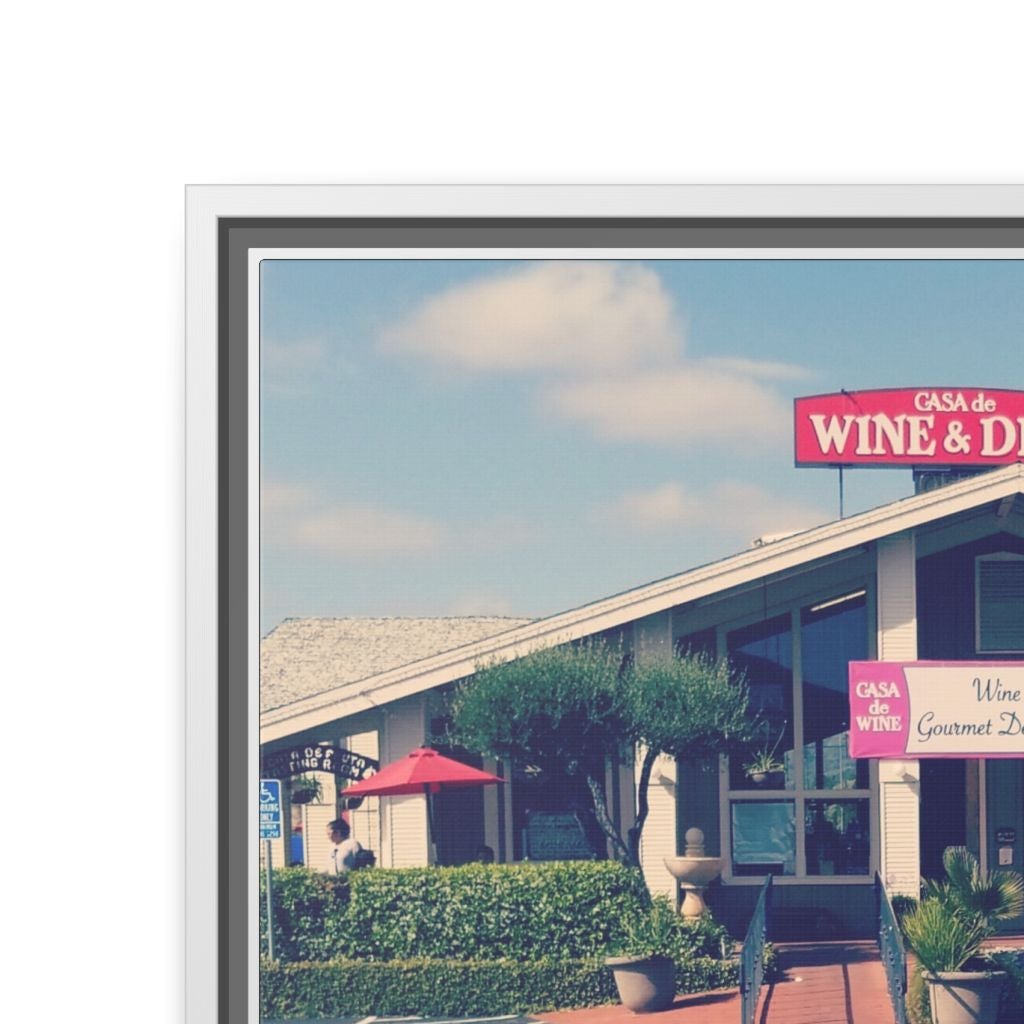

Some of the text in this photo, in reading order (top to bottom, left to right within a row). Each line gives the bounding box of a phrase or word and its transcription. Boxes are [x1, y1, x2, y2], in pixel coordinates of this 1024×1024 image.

[914, 392, 996, 412] CASA de
[809, 413, 937, 456] WINE
[943, 420, 971, 454] &
[856, 681, 900, 698] CASA
[972, 677, 1021, 702] Wine
[869, 699, 889, 714] de
[856, 715, 901, 732] WINE
[917, 712, 992, 742] Gourmet
